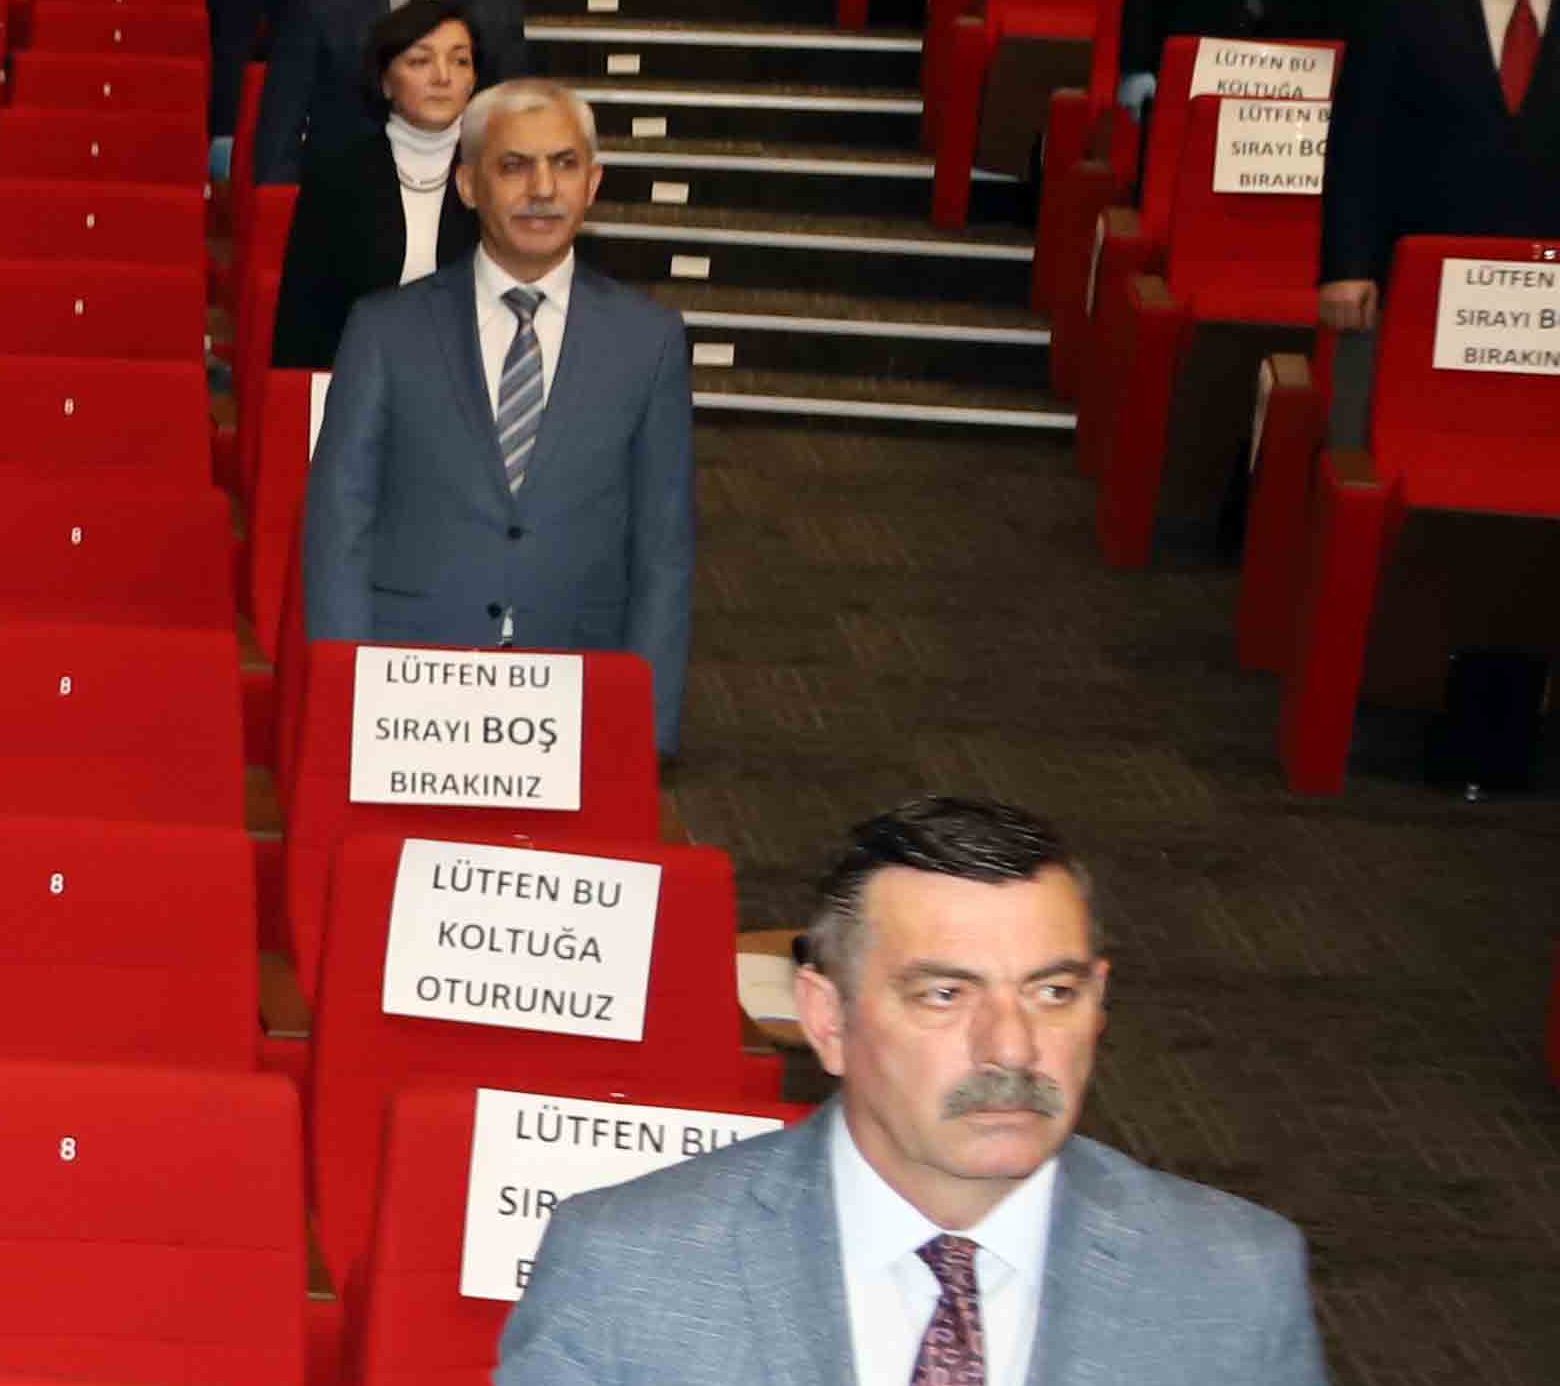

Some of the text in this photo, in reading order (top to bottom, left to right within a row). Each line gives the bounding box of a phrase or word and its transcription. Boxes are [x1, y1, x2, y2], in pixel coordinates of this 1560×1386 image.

[1215, 49, 1316, 72] LÜTFEN BU
[1239, 106, 1311, 123] LÜTFEN
[1231, 138, 1328, 158] SIRAYI BO
[1240, 173, 1320, 188] BIRAKIN
[1466, 264, 1555, 288] LÜTFEN
[1456, 309, 1530, 328] SIRAYI
[1464, 347, 1560, 367] BIRAKIN
[71, 527, 82, 545] 8
[385, 656, 551, 689] LÜTFEN BU
[59, 676, 72, 695] 8
[375, 717, 558, 754] SIRAYI BOŞ
[390, 771, 543, 799] BIRAKINIZ
[50, 873, 64, 894] 8
[432, 859, 623, 908] LÜTFEN BU
[438, 921, 603, 963] KOLTUĞA
[415, 975, 615, 1022] OTURUNUZ
[515, 1105, 665, 1153] LÜTFEN
[60, 1137, 76, 1161] 8
[498, 1185, 559, 1219] SIR
